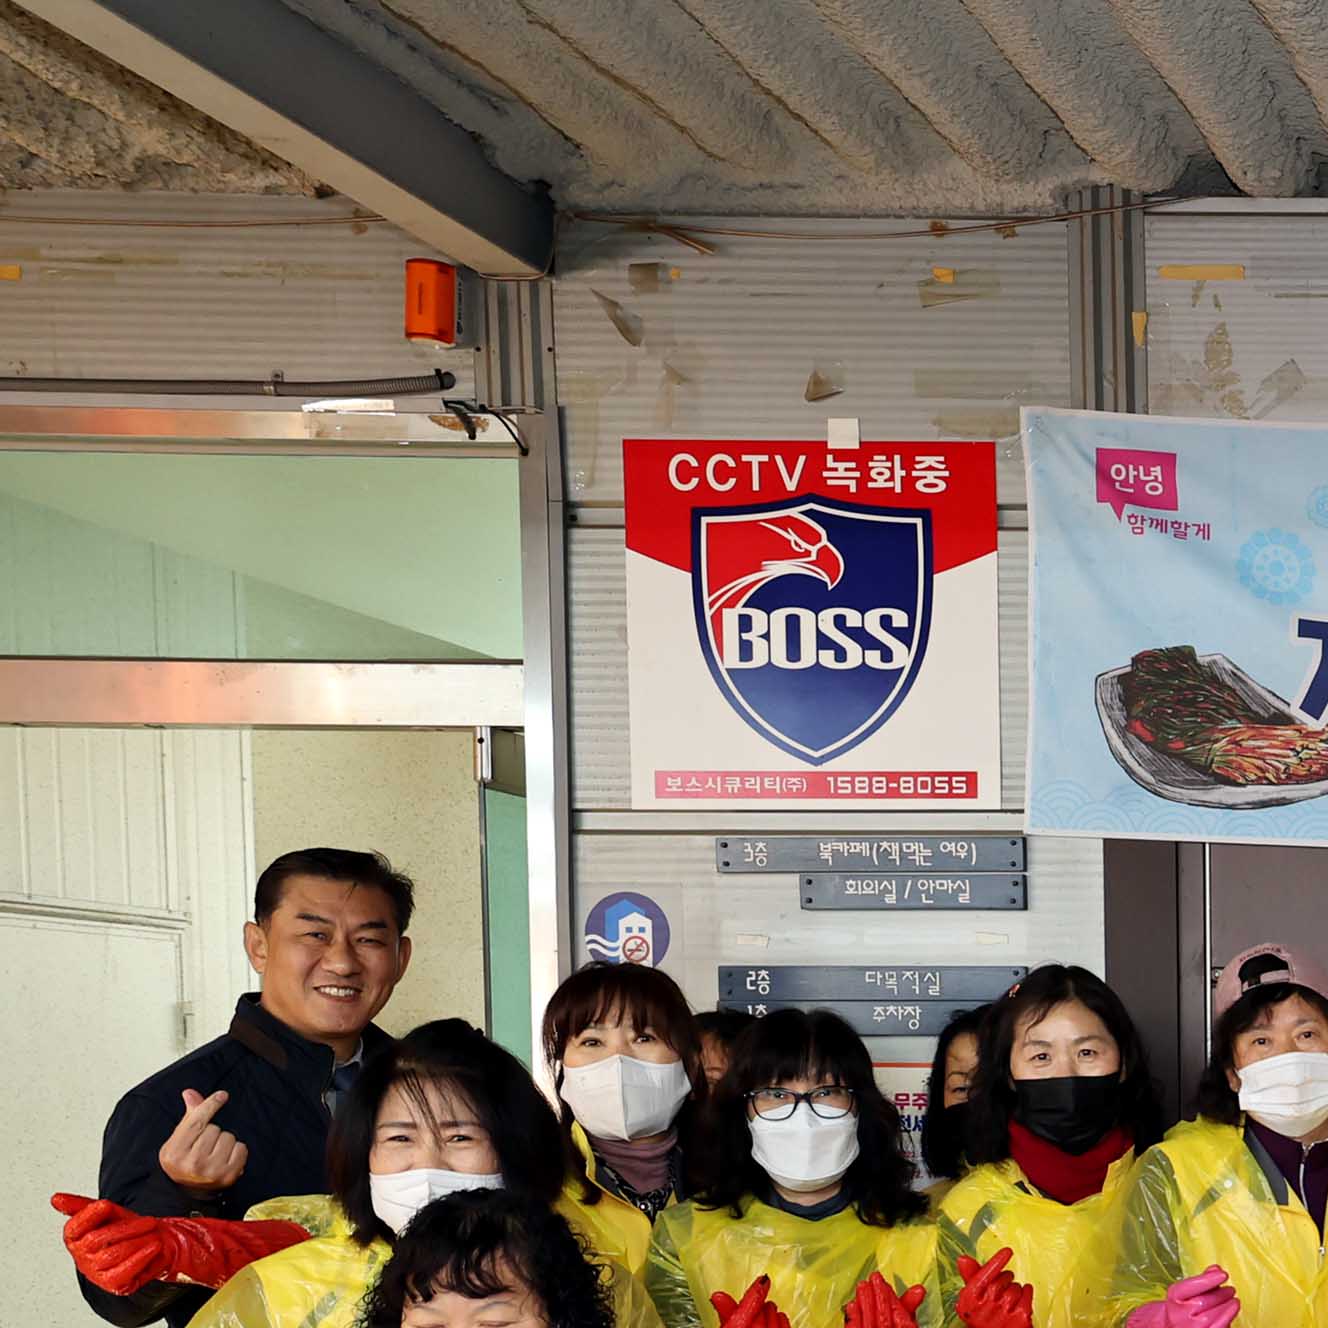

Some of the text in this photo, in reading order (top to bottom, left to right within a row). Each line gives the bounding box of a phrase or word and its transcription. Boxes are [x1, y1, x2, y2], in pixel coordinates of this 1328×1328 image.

[668, 452, 951, 494] CCTV 녹화중
[1110, 463, 1164, 496] 안녕
[1126, 512, 1212, 542] 함께할게
[722, 607, 910, 670] BOSS
[664, 775, 967, 794] 보스시큐리티(주) 1588-8055
[743, 841, 768, 867] 3층
[844, 879, 897, 904] 회의실
[917, 879, 971, 904] 안마실
[746, 969, 940, 996] 2층 다목적실
[872, 1005, 922, 1030] 주차장
